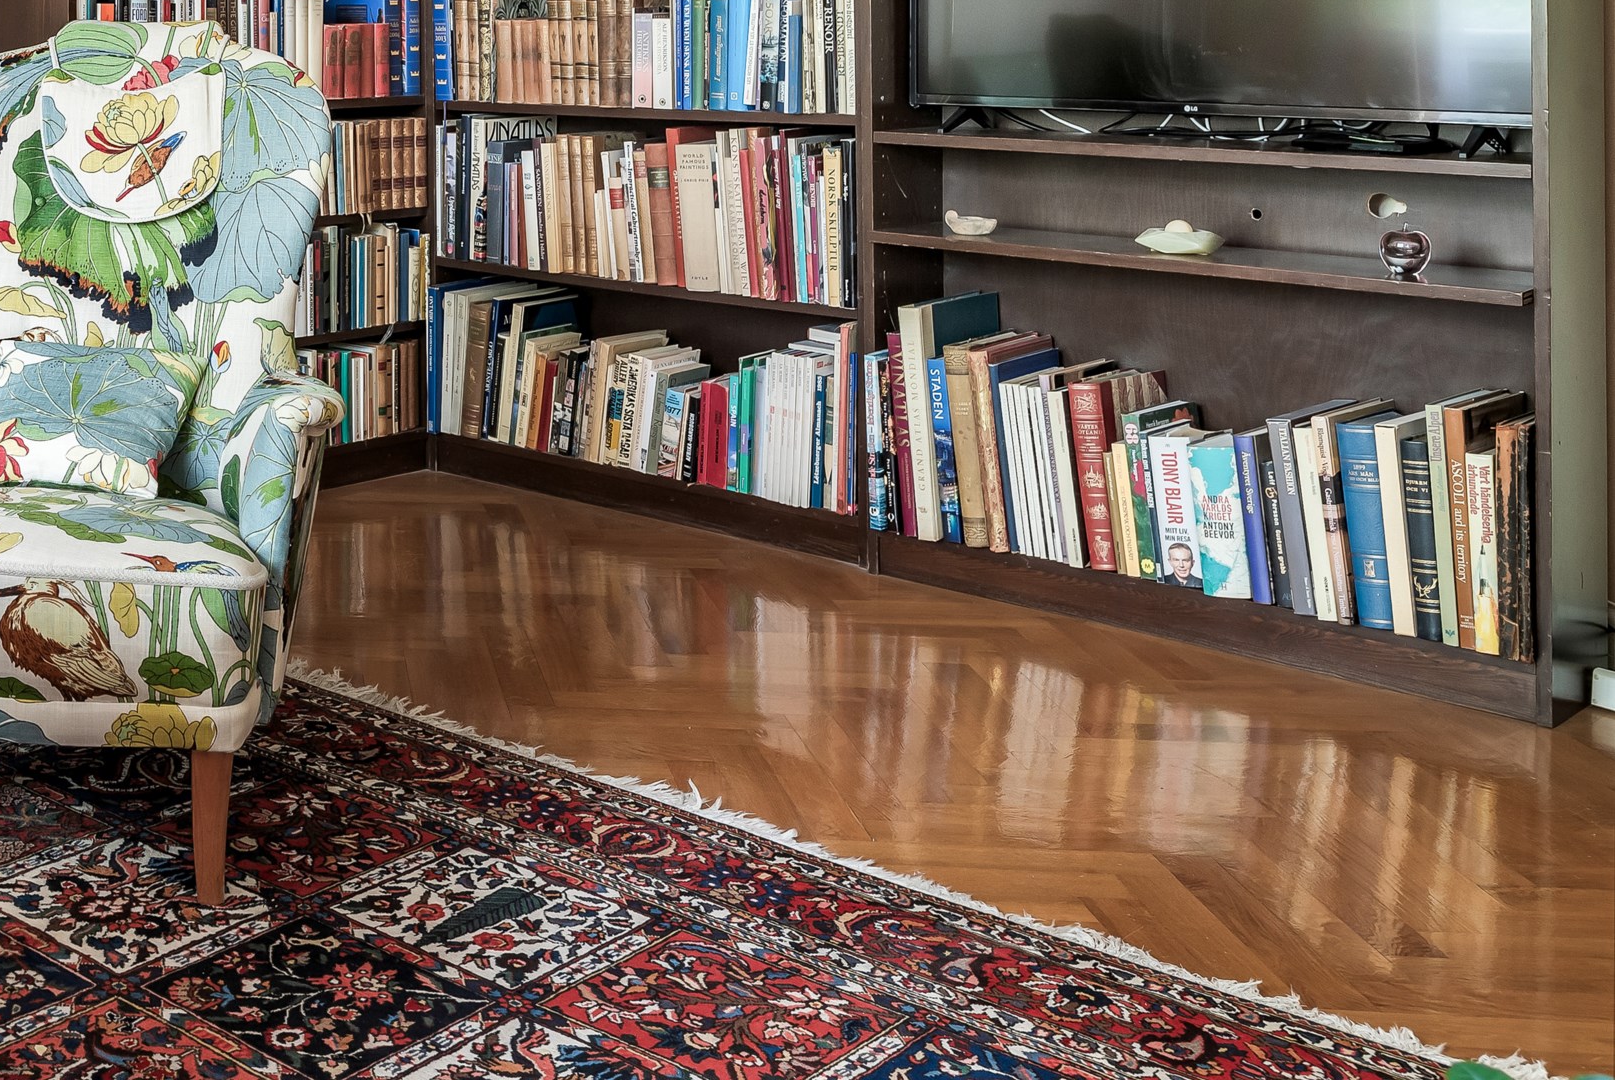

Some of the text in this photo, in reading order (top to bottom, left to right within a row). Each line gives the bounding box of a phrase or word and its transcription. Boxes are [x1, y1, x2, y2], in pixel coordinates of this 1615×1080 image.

[131, 8, 147, 21] FORD
[823, 6, 834, 54] RENOIR
[642, 30, 651, 72] ANTIKENS
[836, 10, 846, 77] REMBRANDT
[471, 151, 481, 191] VINATLAS
[535, 168, 543, 207] SANDVIKEN
[625, 167, 642, 263] Impractical Cabinetmaker
[730, 137, 749, 290] KONSTSKATTER WIEN
[828, 168, 838, 272] NORSK SKULPTUR
[731, 240, 740, 271] KONST
[484, 341, 494, 393] MONTE-CARLO
[618, 359, 627, 384] ALLEN
[621, 366, 639, 434] AMERIKAS SISTA
[664, 404, 681, 416] 1977
[930, 368, 944, 420] STADEN
[604, 420, 614, 451] SOCIETY
[814, 400, 822, 436] Almanach
[909, 340, 926, 491] GRAND ATLAS MONDIAL
[1124, 422, 1140, 445] 68
[1430, 411, 1442, 462] Unsere Alpen
[1140, 438, 1154, 508] Boken BERGSLAGEN
[1278, 427, 1296, 496] ITALIAN FASHION
[1053, 479, 1061, 504] WOOD
[1161, 451, 1184, 525] TONY BLAIR
[1201, 502, 1233, 513] VÄRLDS
[1202, 495, 1230, 504] ANDRA
[1246, 487, 1255, 515] Sverige
[1467, 464, 1478, 516] århundrade
[1479, 465, 1492, 544] Vårt händelserika
[1165, 527, 1178, 535] MITT
[1202, 521, 1235, 531] ANTONY
[1203, 512, 1233, 521] KRIGET
[1204, 529, 1236, 540] BEEVOR
[1267, 471, 1286, 575] Leif Persson Gustavs grabb
[1316, 427, 1327, 459] Blomquist
[1338, 593, 1347, 618] Timbro
[1451, 459, 1472, 583] ASCOLI and its territory
[1177, 535, 1191, 543] RESA
